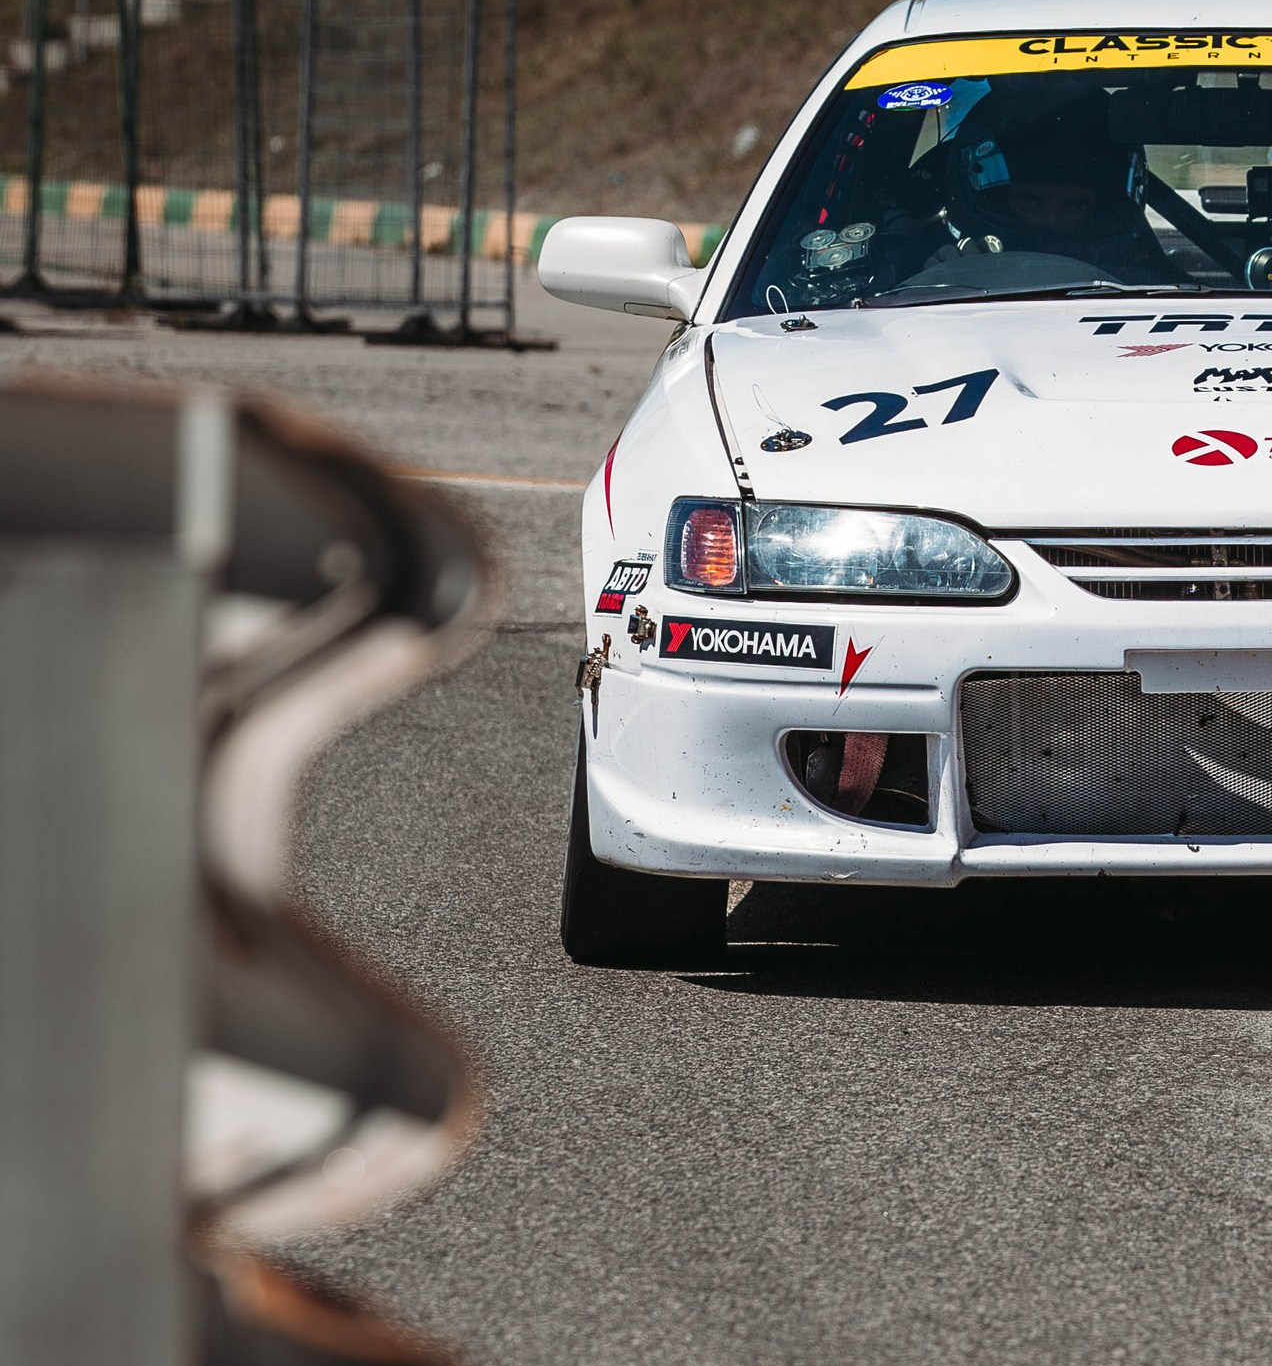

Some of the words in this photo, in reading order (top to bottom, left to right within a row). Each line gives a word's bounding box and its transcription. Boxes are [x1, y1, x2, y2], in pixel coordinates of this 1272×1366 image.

[1018, 35, 1258, 55] CLASSIC
[822, 368, 1002, 446] 27
[604, 566, 649, 592] АВТО
[690, 626, 817, 660] YOKOHAMA
